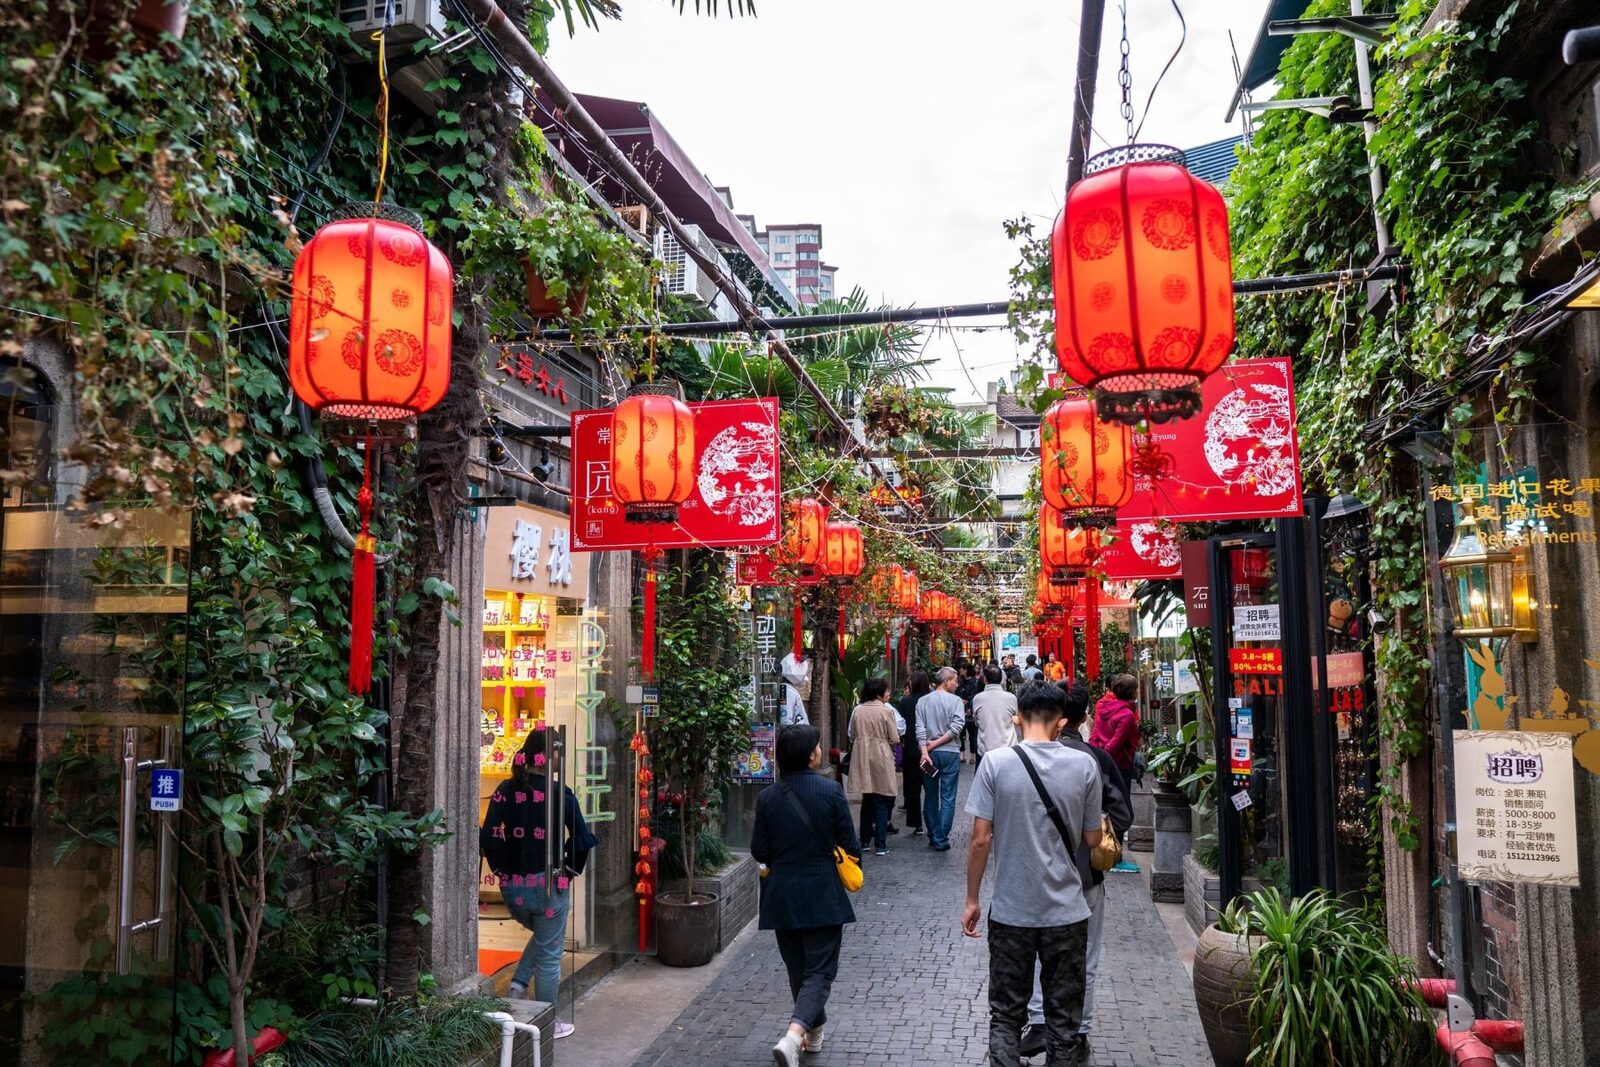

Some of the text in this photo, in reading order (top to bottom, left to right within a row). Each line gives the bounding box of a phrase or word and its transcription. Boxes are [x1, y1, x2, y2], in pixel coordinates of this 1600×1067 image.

[587, 505, 619, 516] (kang)
[1478, 530, 1598, 546] Refreshments
[1192, 586, 1209, 600] 石
[1247, 609, 1269, 621] 招聘
[756, 615, 778, 713] 动手做一件
[1492, 758, 1537, 777] 招聘
[158, 775, 174, 795] 推
[154, 800, 175, 808] PUSH
[1504, 800, 1544, 809] 销售顾问
[1505, 841, 1556, 852] 经验者优先
